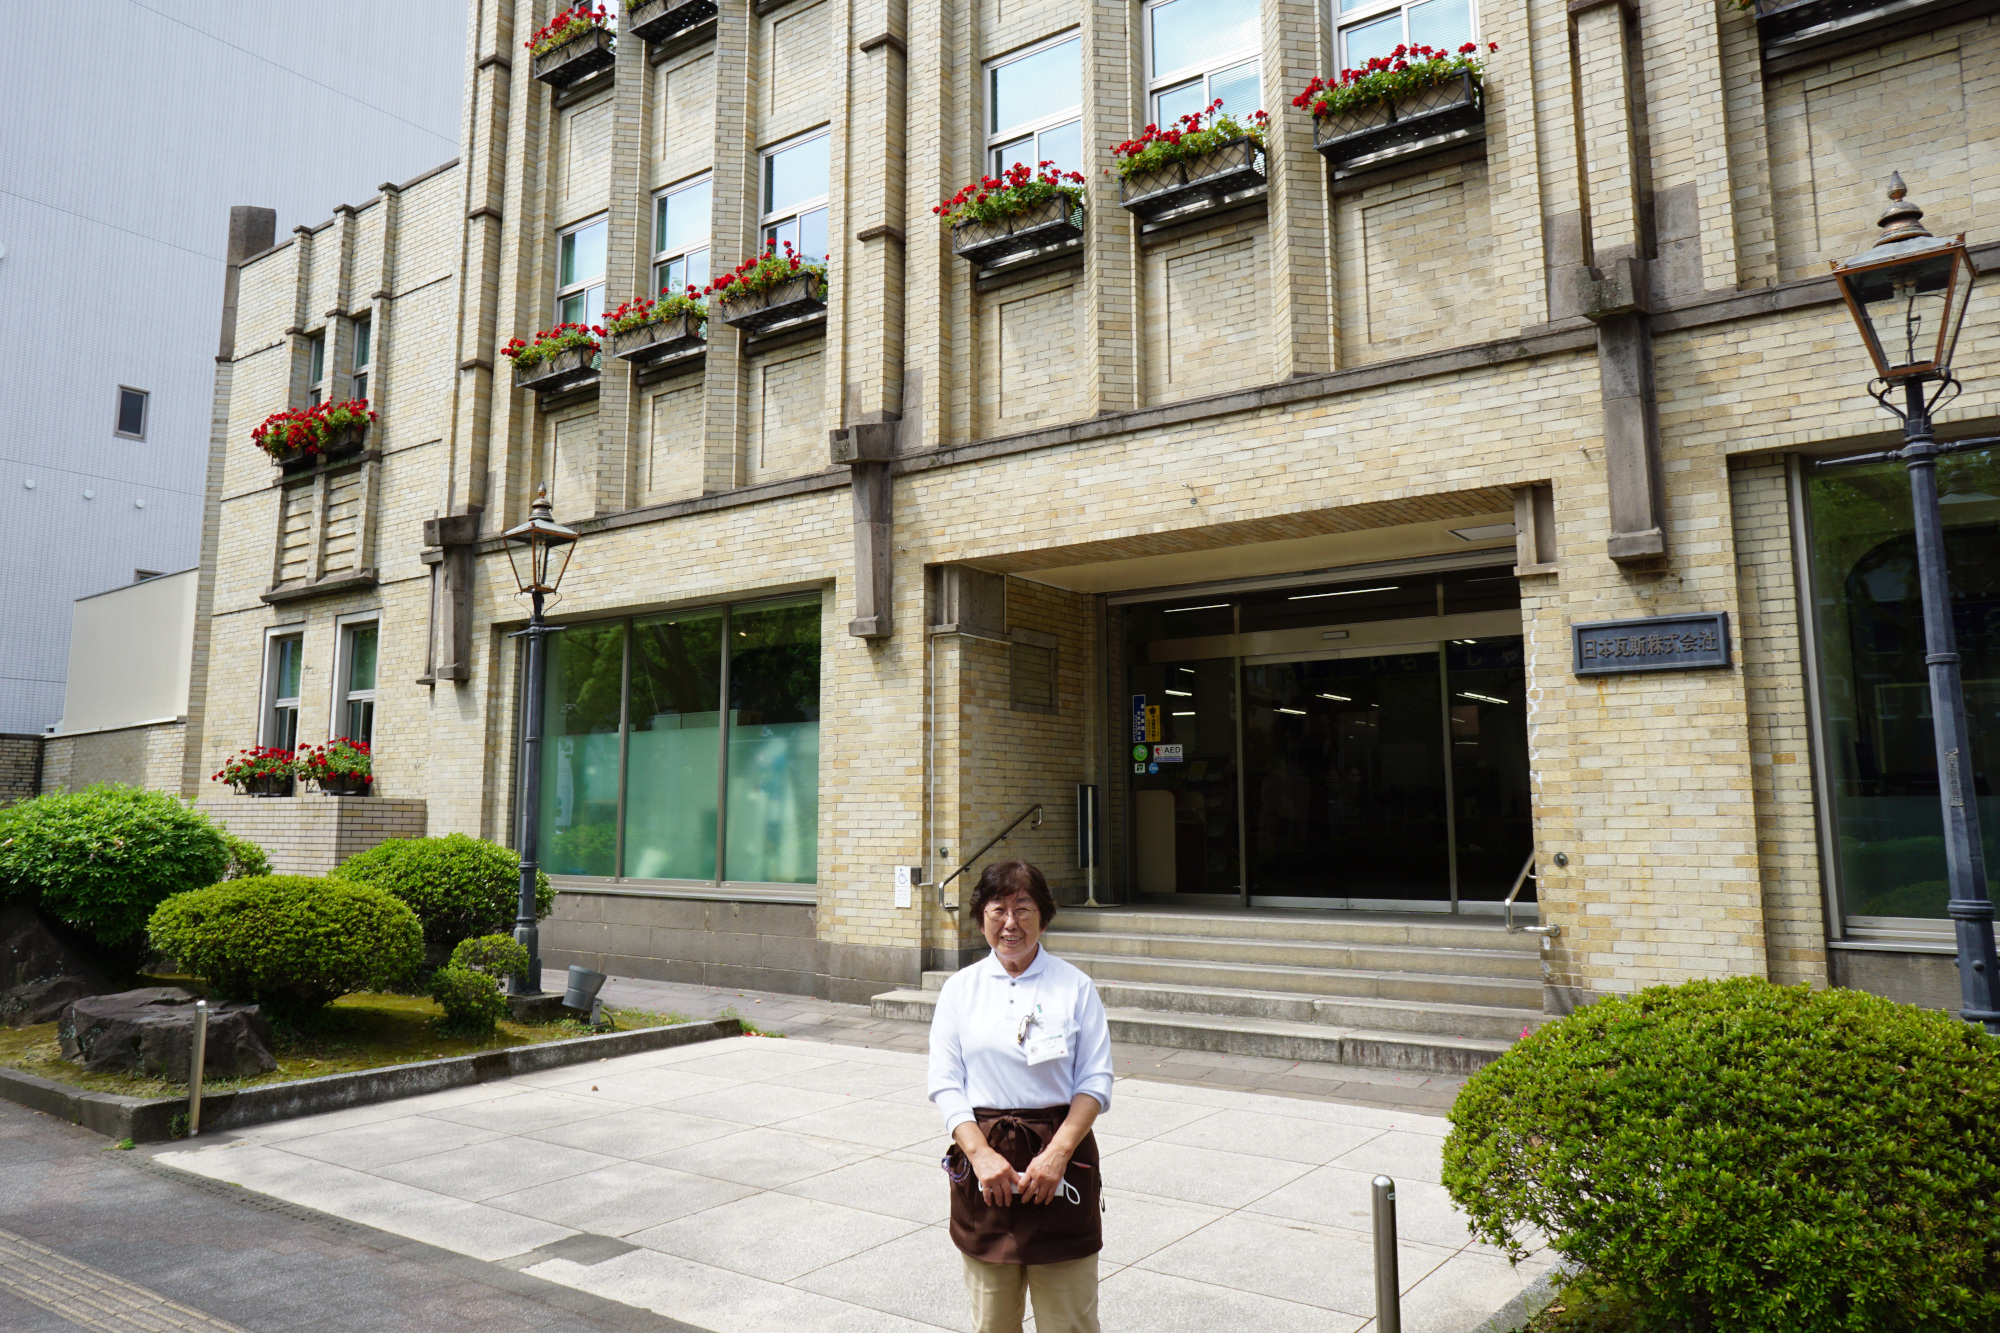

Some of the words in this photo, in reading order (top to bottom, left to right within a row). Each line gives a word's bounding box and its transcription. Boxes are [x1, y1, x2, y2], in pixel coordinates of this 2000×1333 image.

[1583, 629, 1718, 659] 日本瓦斯株式会社
[1164, 746, 1181, 754] AED
